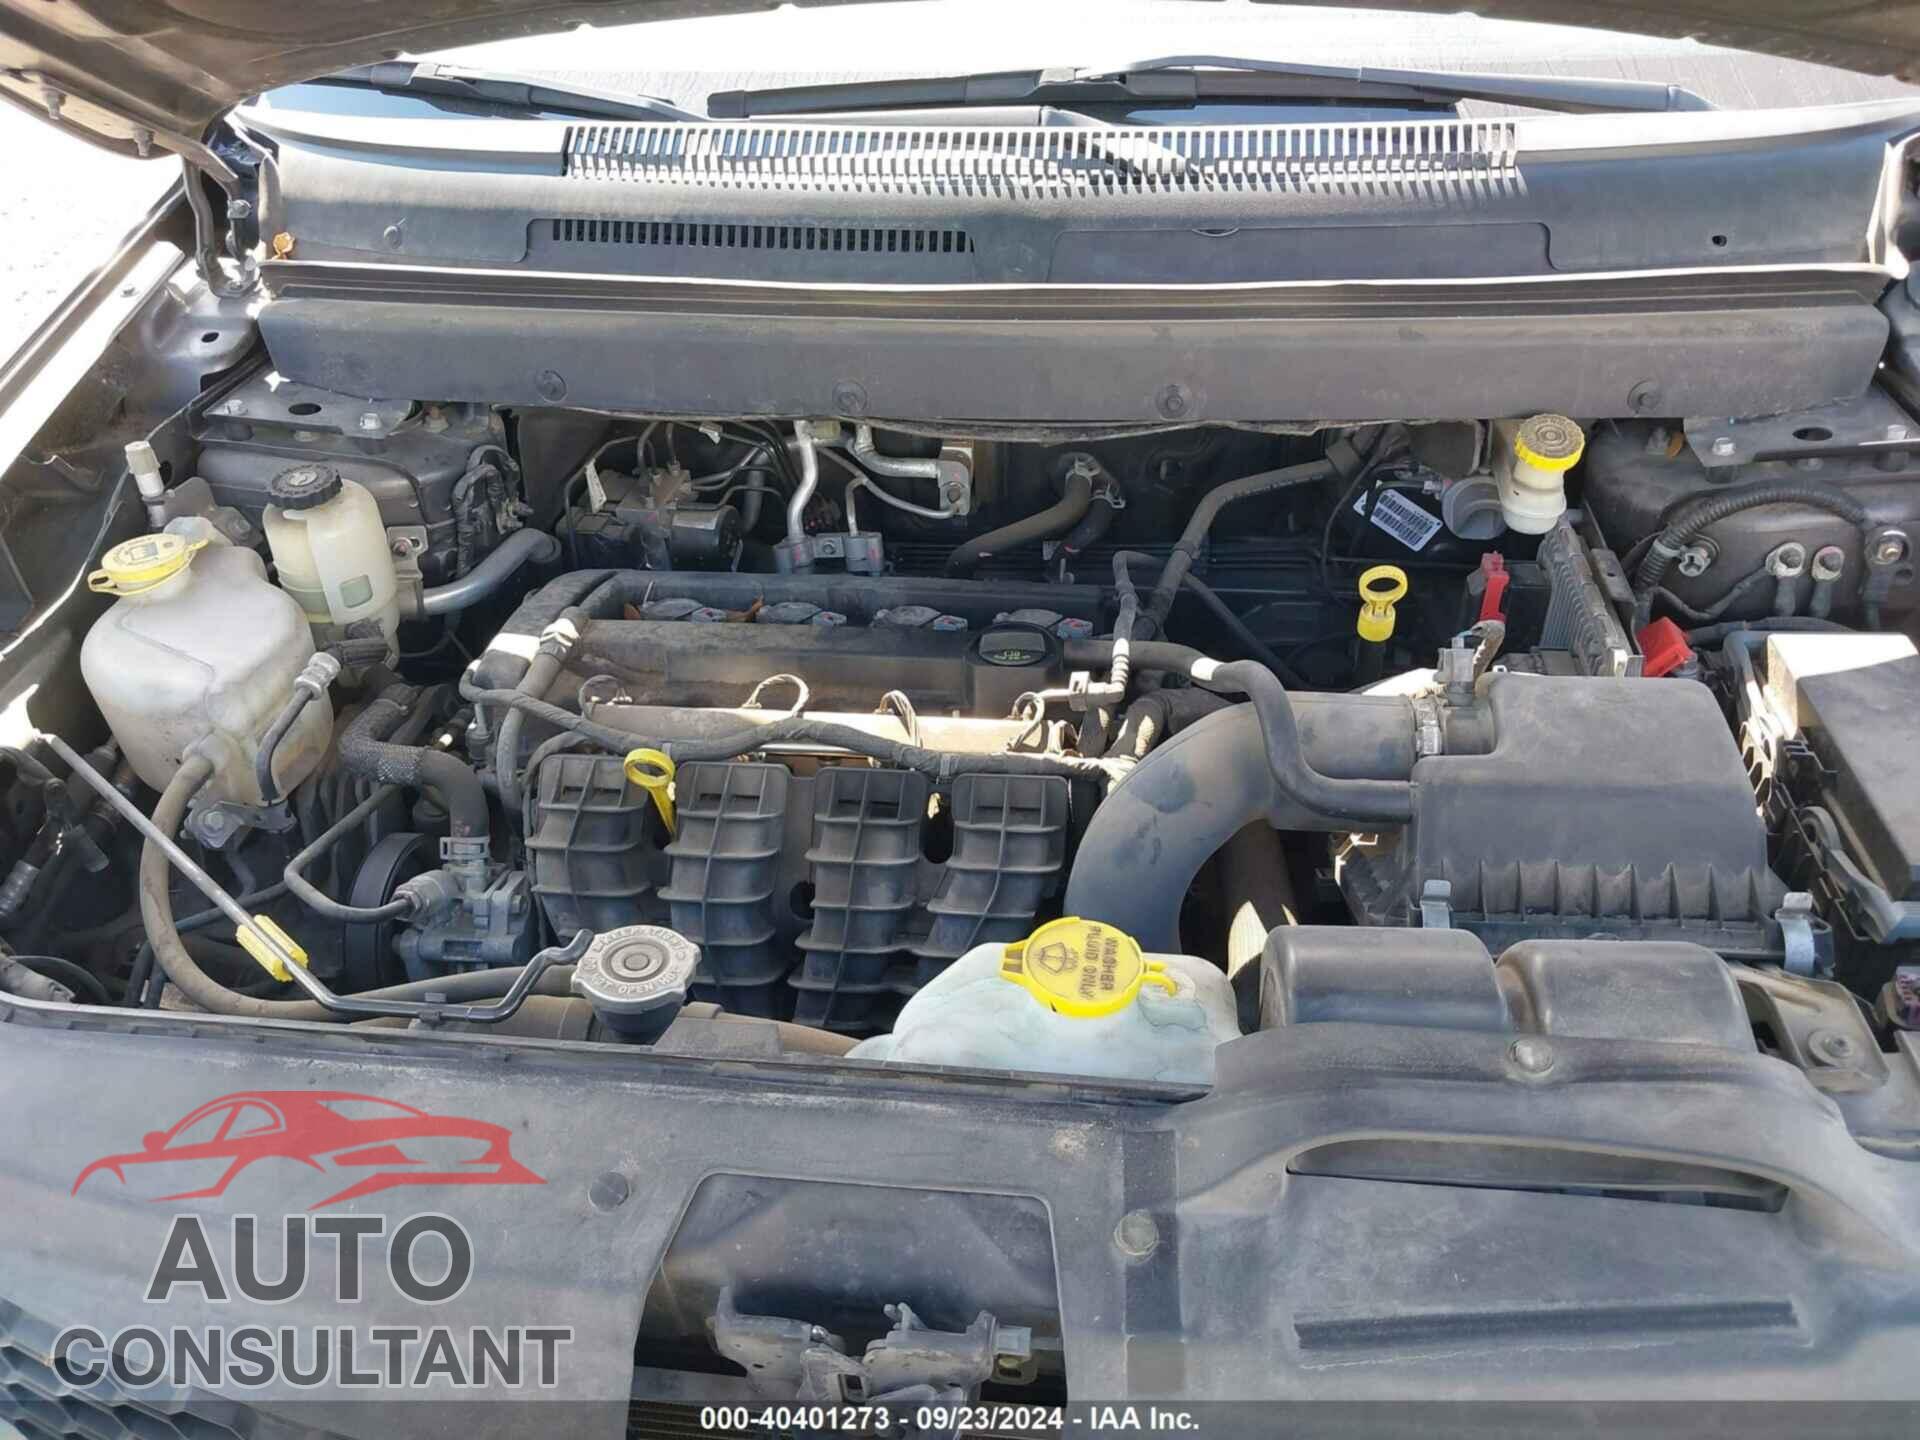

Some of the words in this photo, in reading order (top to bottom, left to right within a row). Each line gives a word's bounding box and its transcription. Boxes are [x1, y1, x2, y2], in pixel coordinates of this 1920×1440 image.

[1084, 926, 1102, 961] FLUID
[1100, 937, 1118, 991] WASHER
[1079, 965, 1098, 999] ONLY
